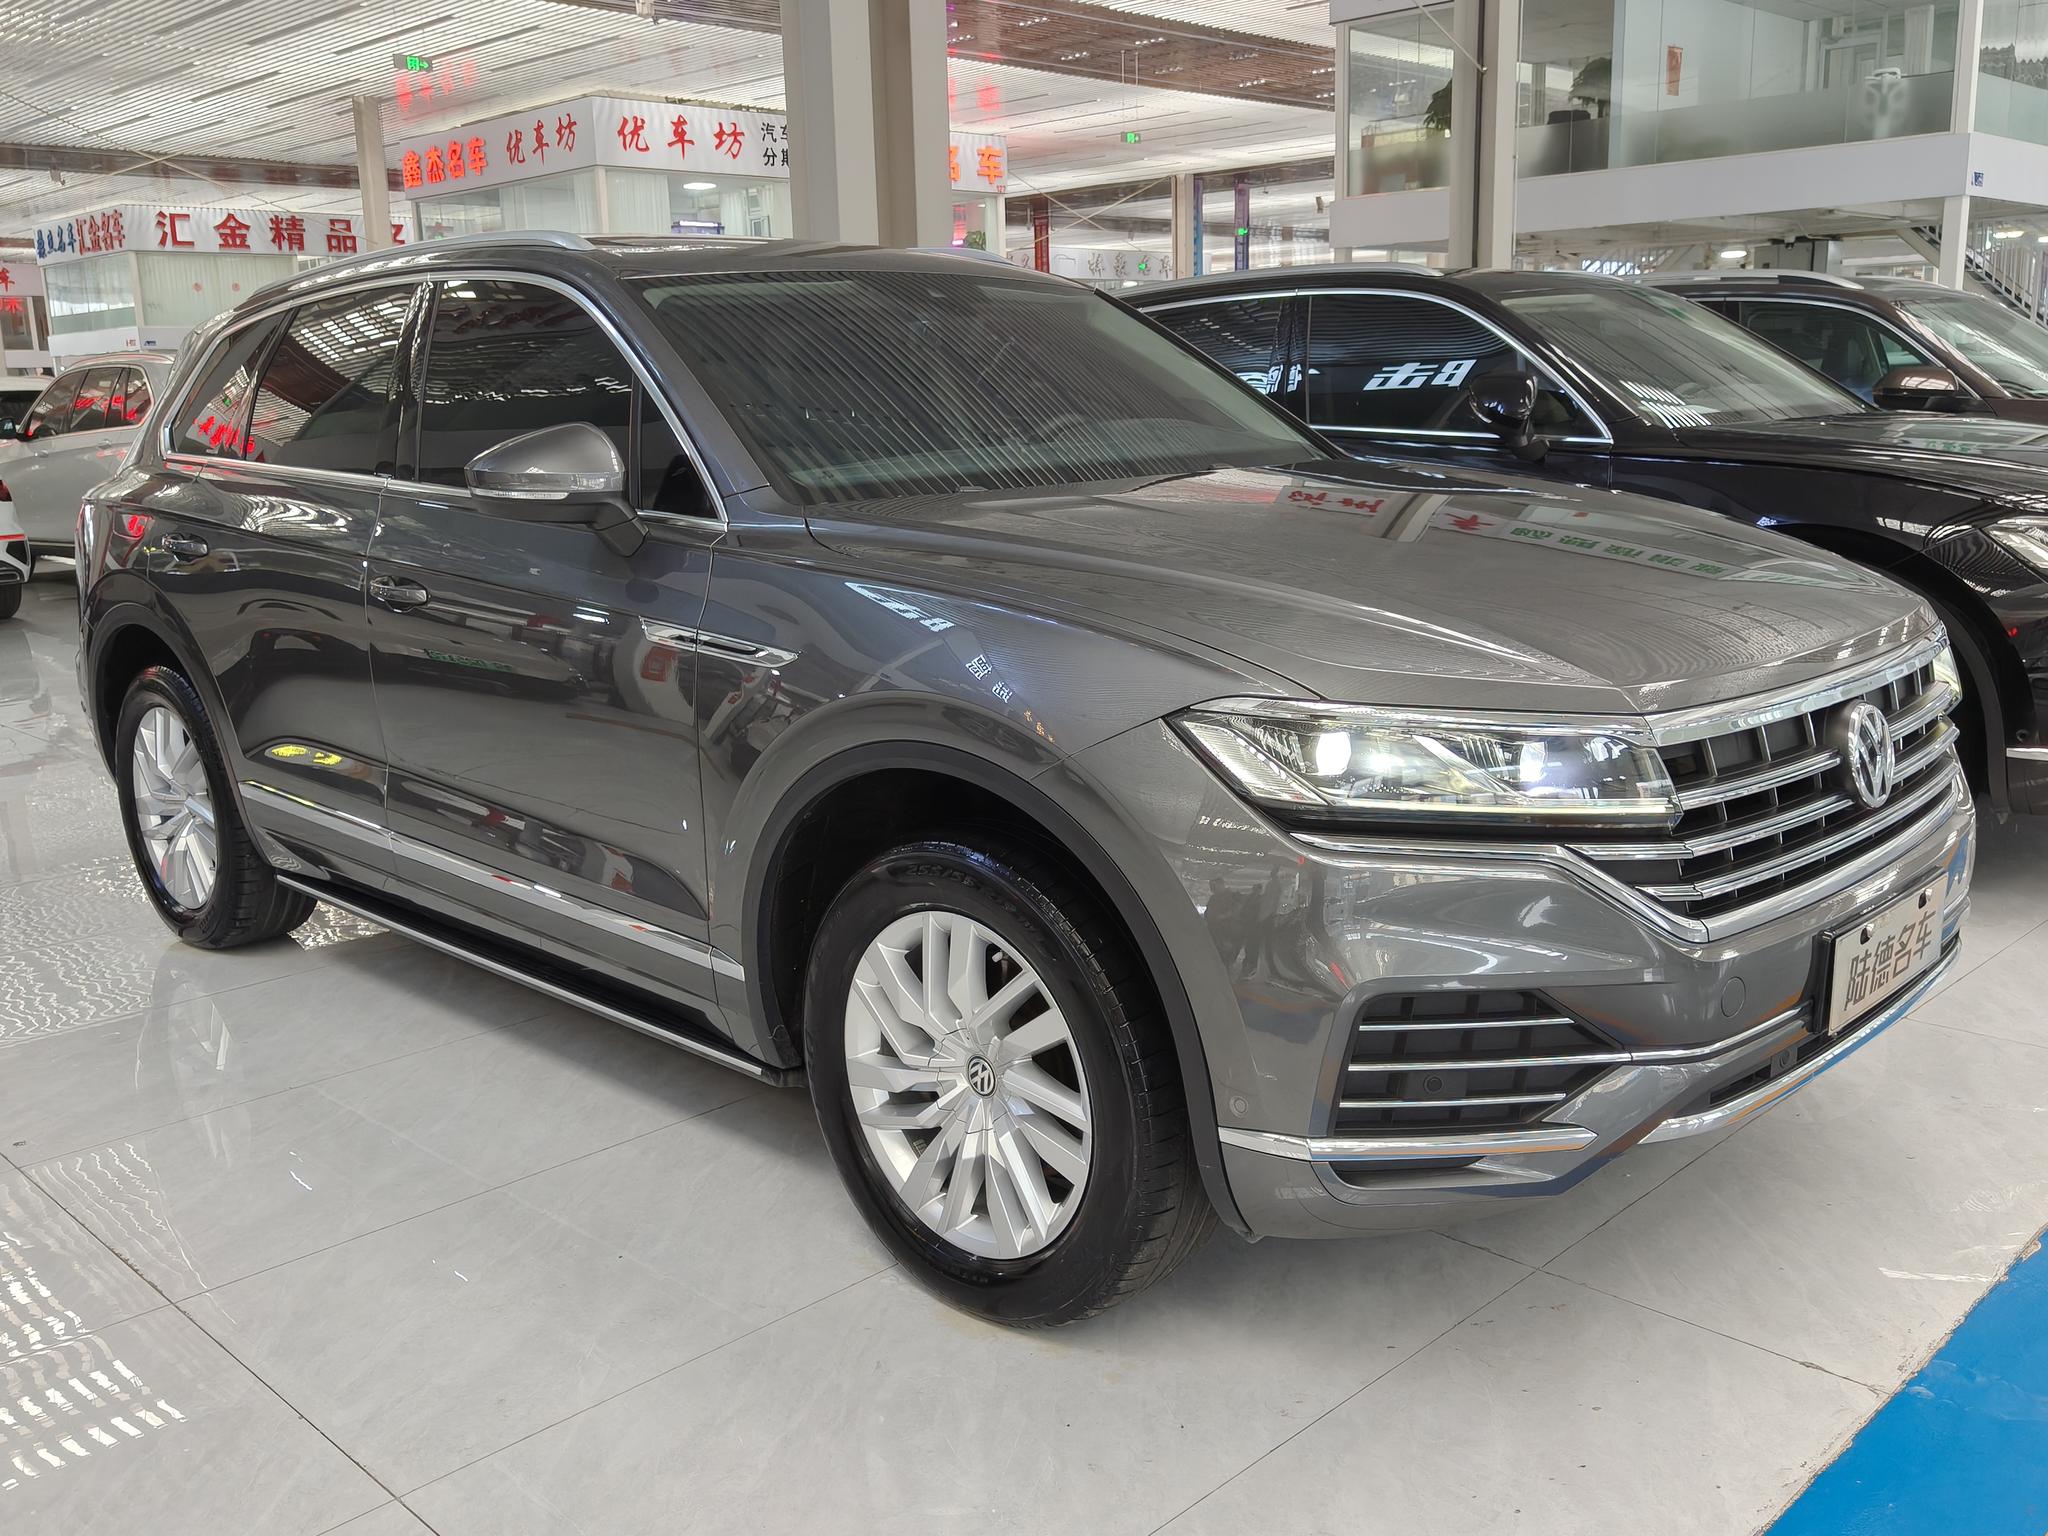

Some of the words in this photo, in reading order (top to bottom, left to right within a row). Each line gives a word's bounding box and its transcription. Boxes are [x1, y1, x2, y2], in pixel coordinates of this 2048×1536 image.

[506, 113, 577, 165] 优车坊
[617, 105, 745, 160] 优车坊
[402, 136, 488, 189] 鑫杰名车
[1844, 911, 1936, 1011] 陆德名车
